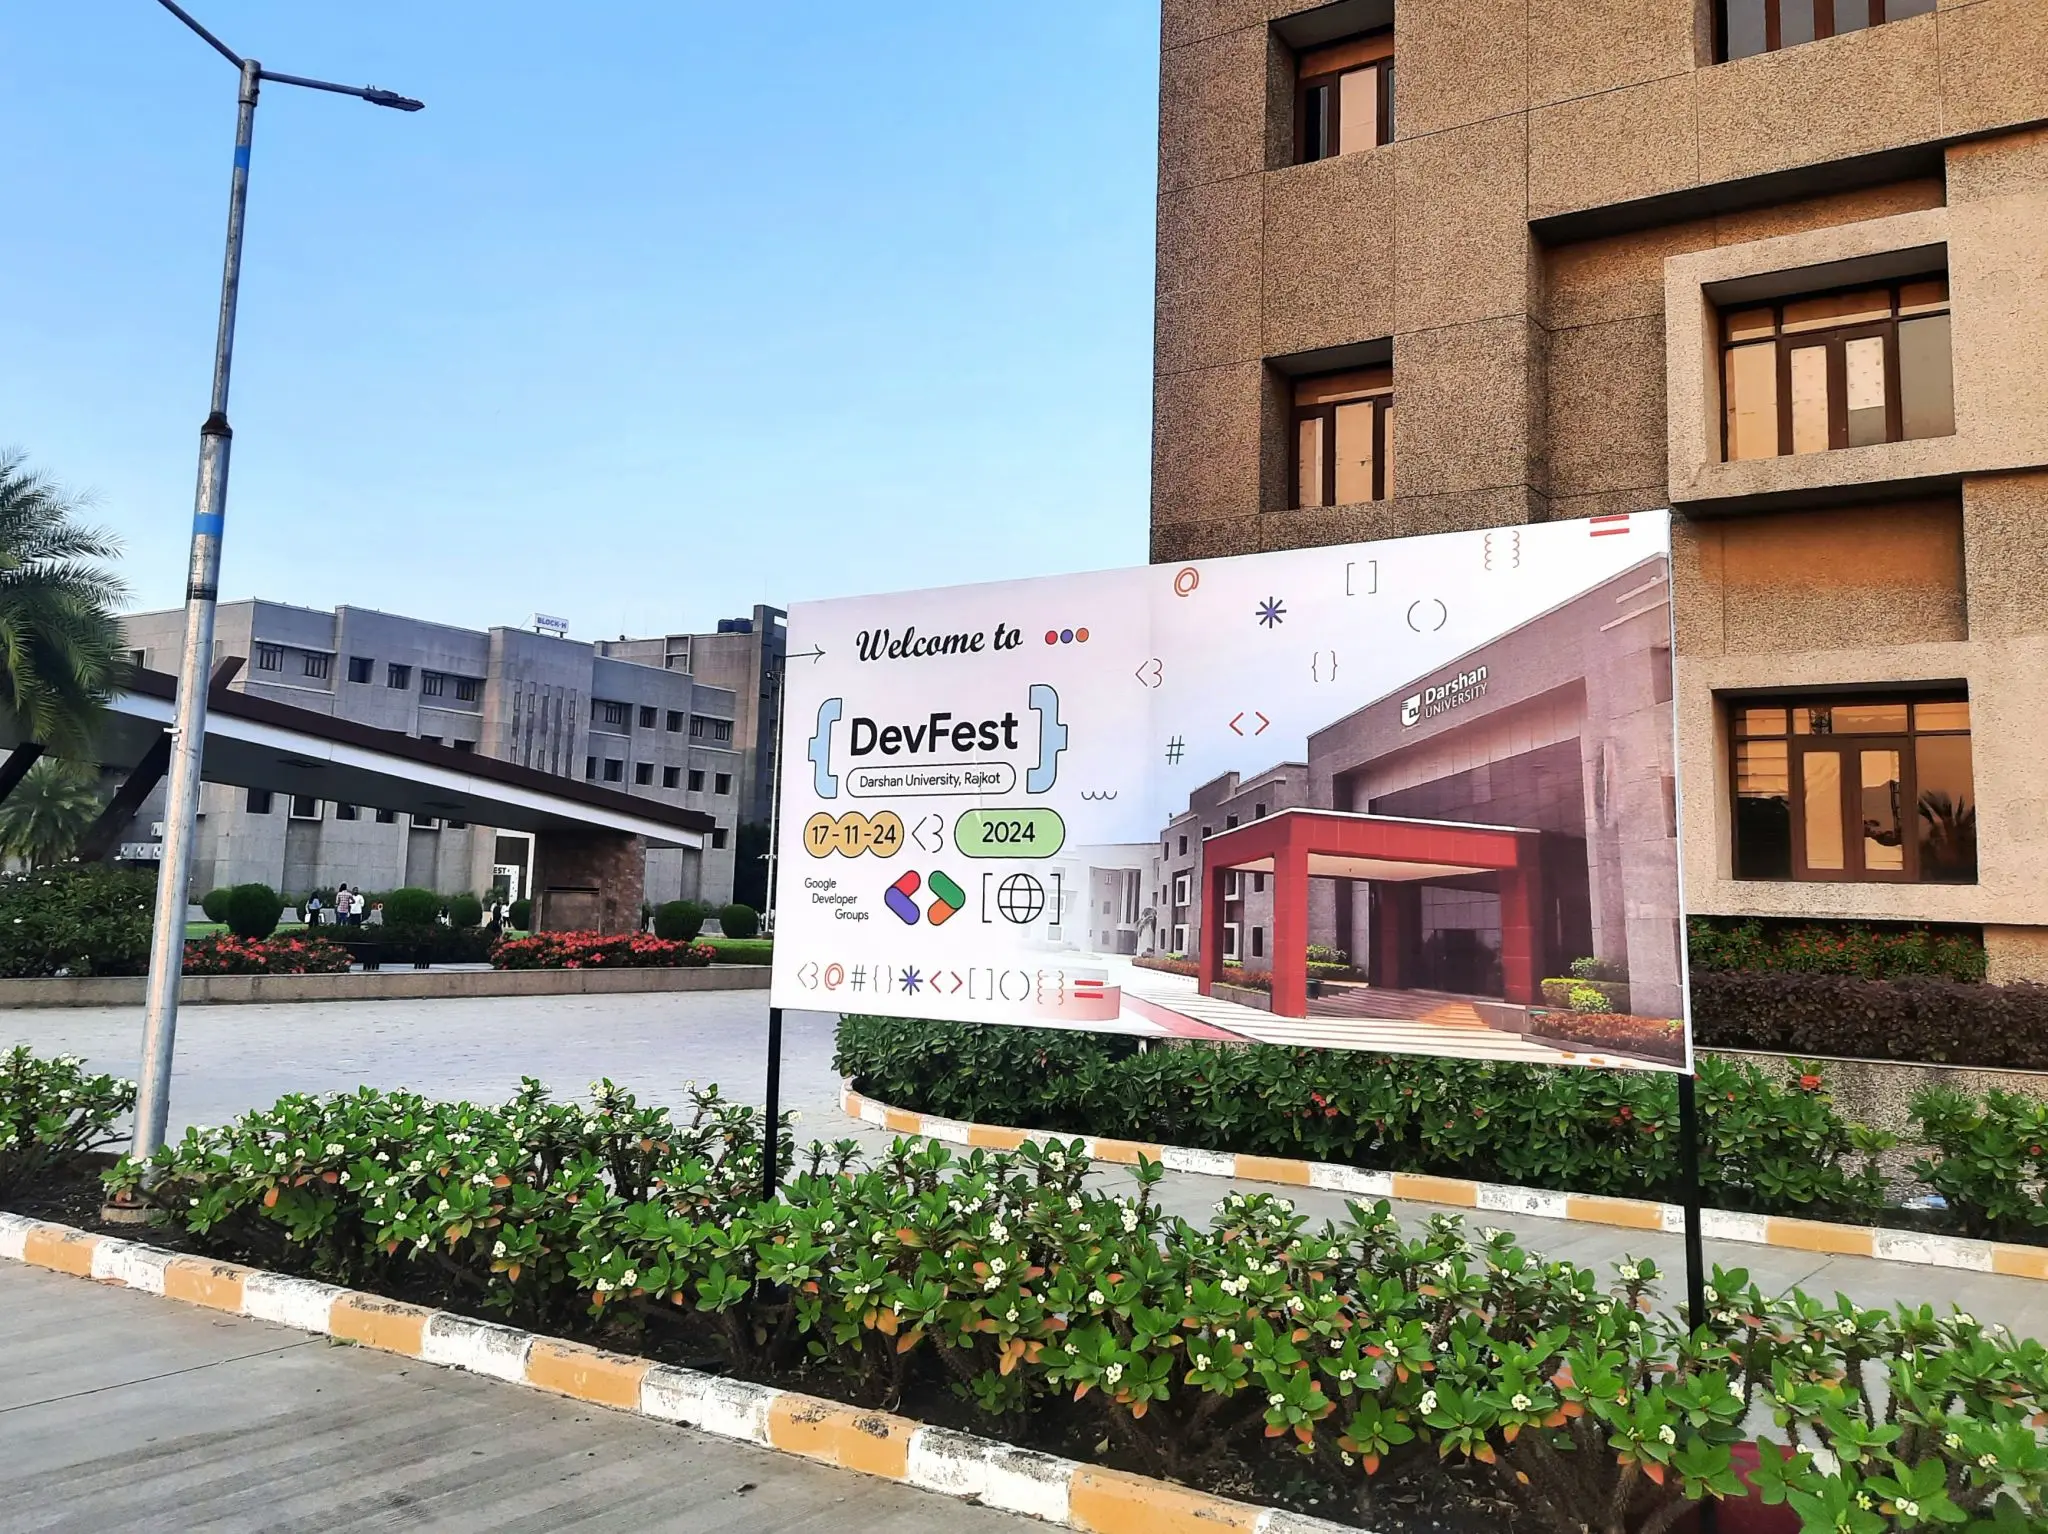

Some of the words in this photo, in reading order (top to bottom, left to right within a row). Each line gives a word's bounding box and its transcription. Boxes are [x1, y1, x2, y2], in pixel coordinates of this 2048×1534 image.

[856, 626, 985, 662] Welcome
[994, 622, 1023, 651] to
[1425, 665, 1487, 705] Darshan
[1425, 683, 1487, 718] UNIVERSITY
[850, 712, 1018, 756] DevFest
[860, 773, 903, 788] Darshan
[905, 771, 962, 788] University,
[964, 771, 1001, 788] Rajkot
[982, 821, 1036, 843] 2024
[804, 877, 837, 890] Google
[812, 892, 858, 905] Developer
[835, 908, 869, 921] Groups
